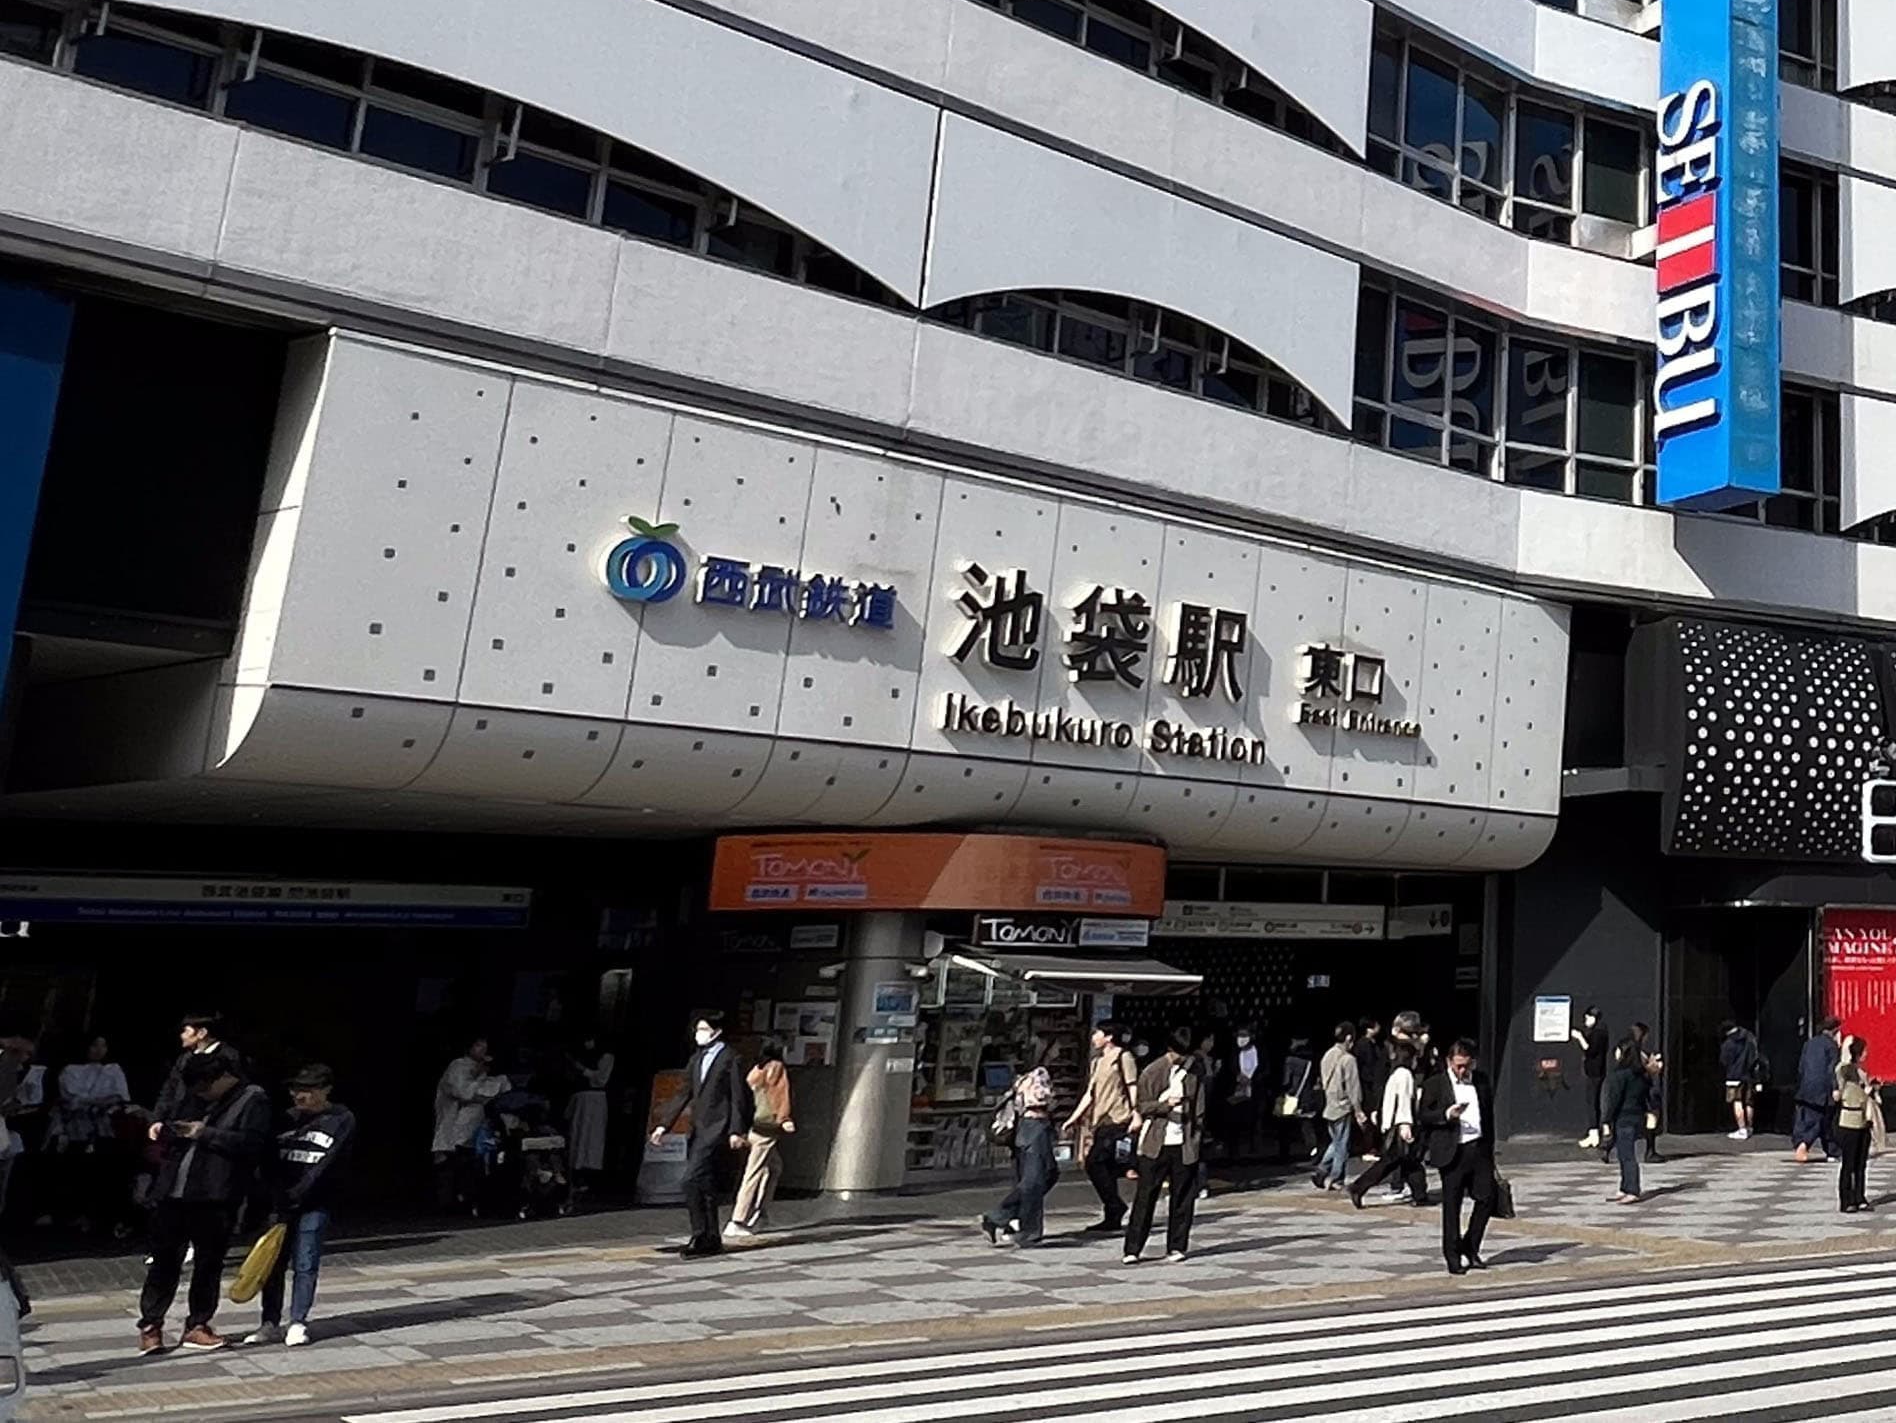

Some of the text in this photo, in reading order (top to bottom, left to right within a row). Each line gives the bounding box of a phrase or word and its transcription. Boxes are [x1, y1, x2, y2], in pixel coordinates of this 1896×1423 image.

[1652, 78, 1720, 444] SEIBU
[695, 552, 897, 631] 西武鉄道
[949, 563, 1249, 703] 池袋駅
[1298, 641, 1386, 705] 東口
[938, 692, 1267, 766] Ikebukuro Station
